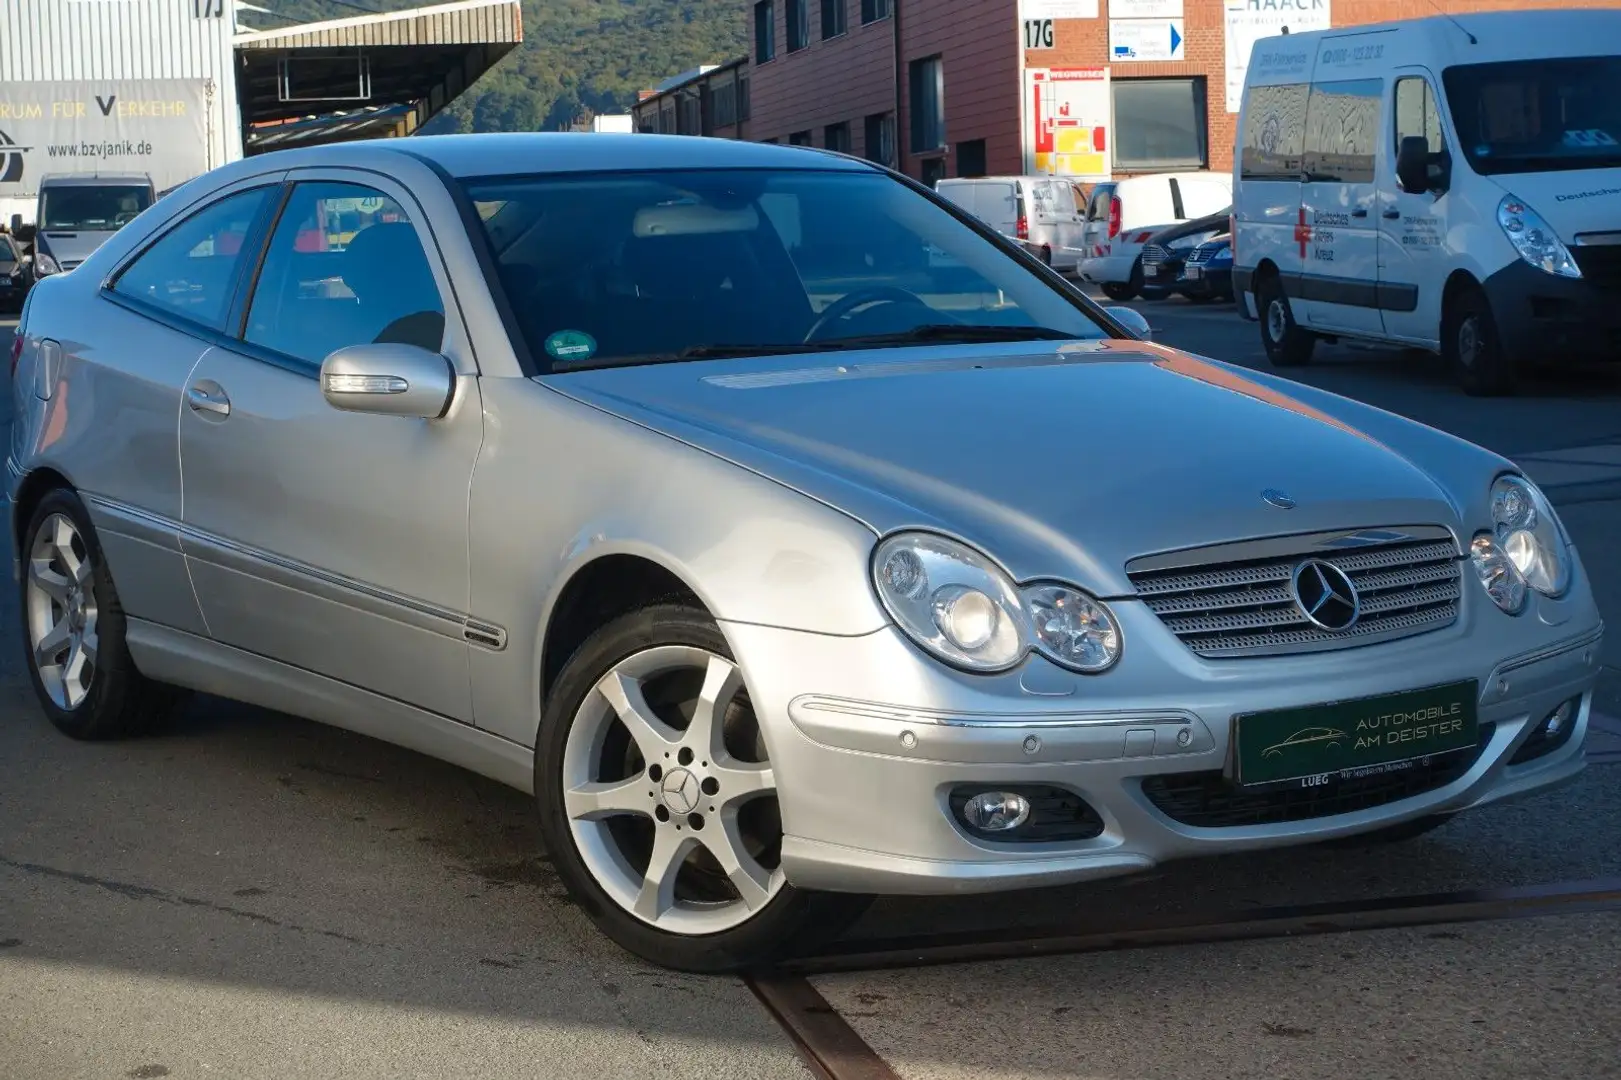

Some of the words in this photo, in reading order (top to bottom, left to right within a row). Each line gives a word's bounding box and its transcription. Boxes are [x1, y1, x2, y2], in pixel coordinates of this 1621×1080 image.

[1025, 19, 1054, 48] 17G
[1050, 70, 1104, 79] WEGWEISER
[52, 99, 86, 118] FÜR
[95, 95, 187, 117] VERKEHR
[47, 139, 153, 160] www.bzvjanik.de
[1554, 187, 1621, 202] Deutsche
[1355, 702, 1462, 731] AUTOMOBILE
[1353, 731, 1381, 750] AM
[1386, 719, 1463, 745] DEISTER
[1301, 774, 1329, 788] LUEG
